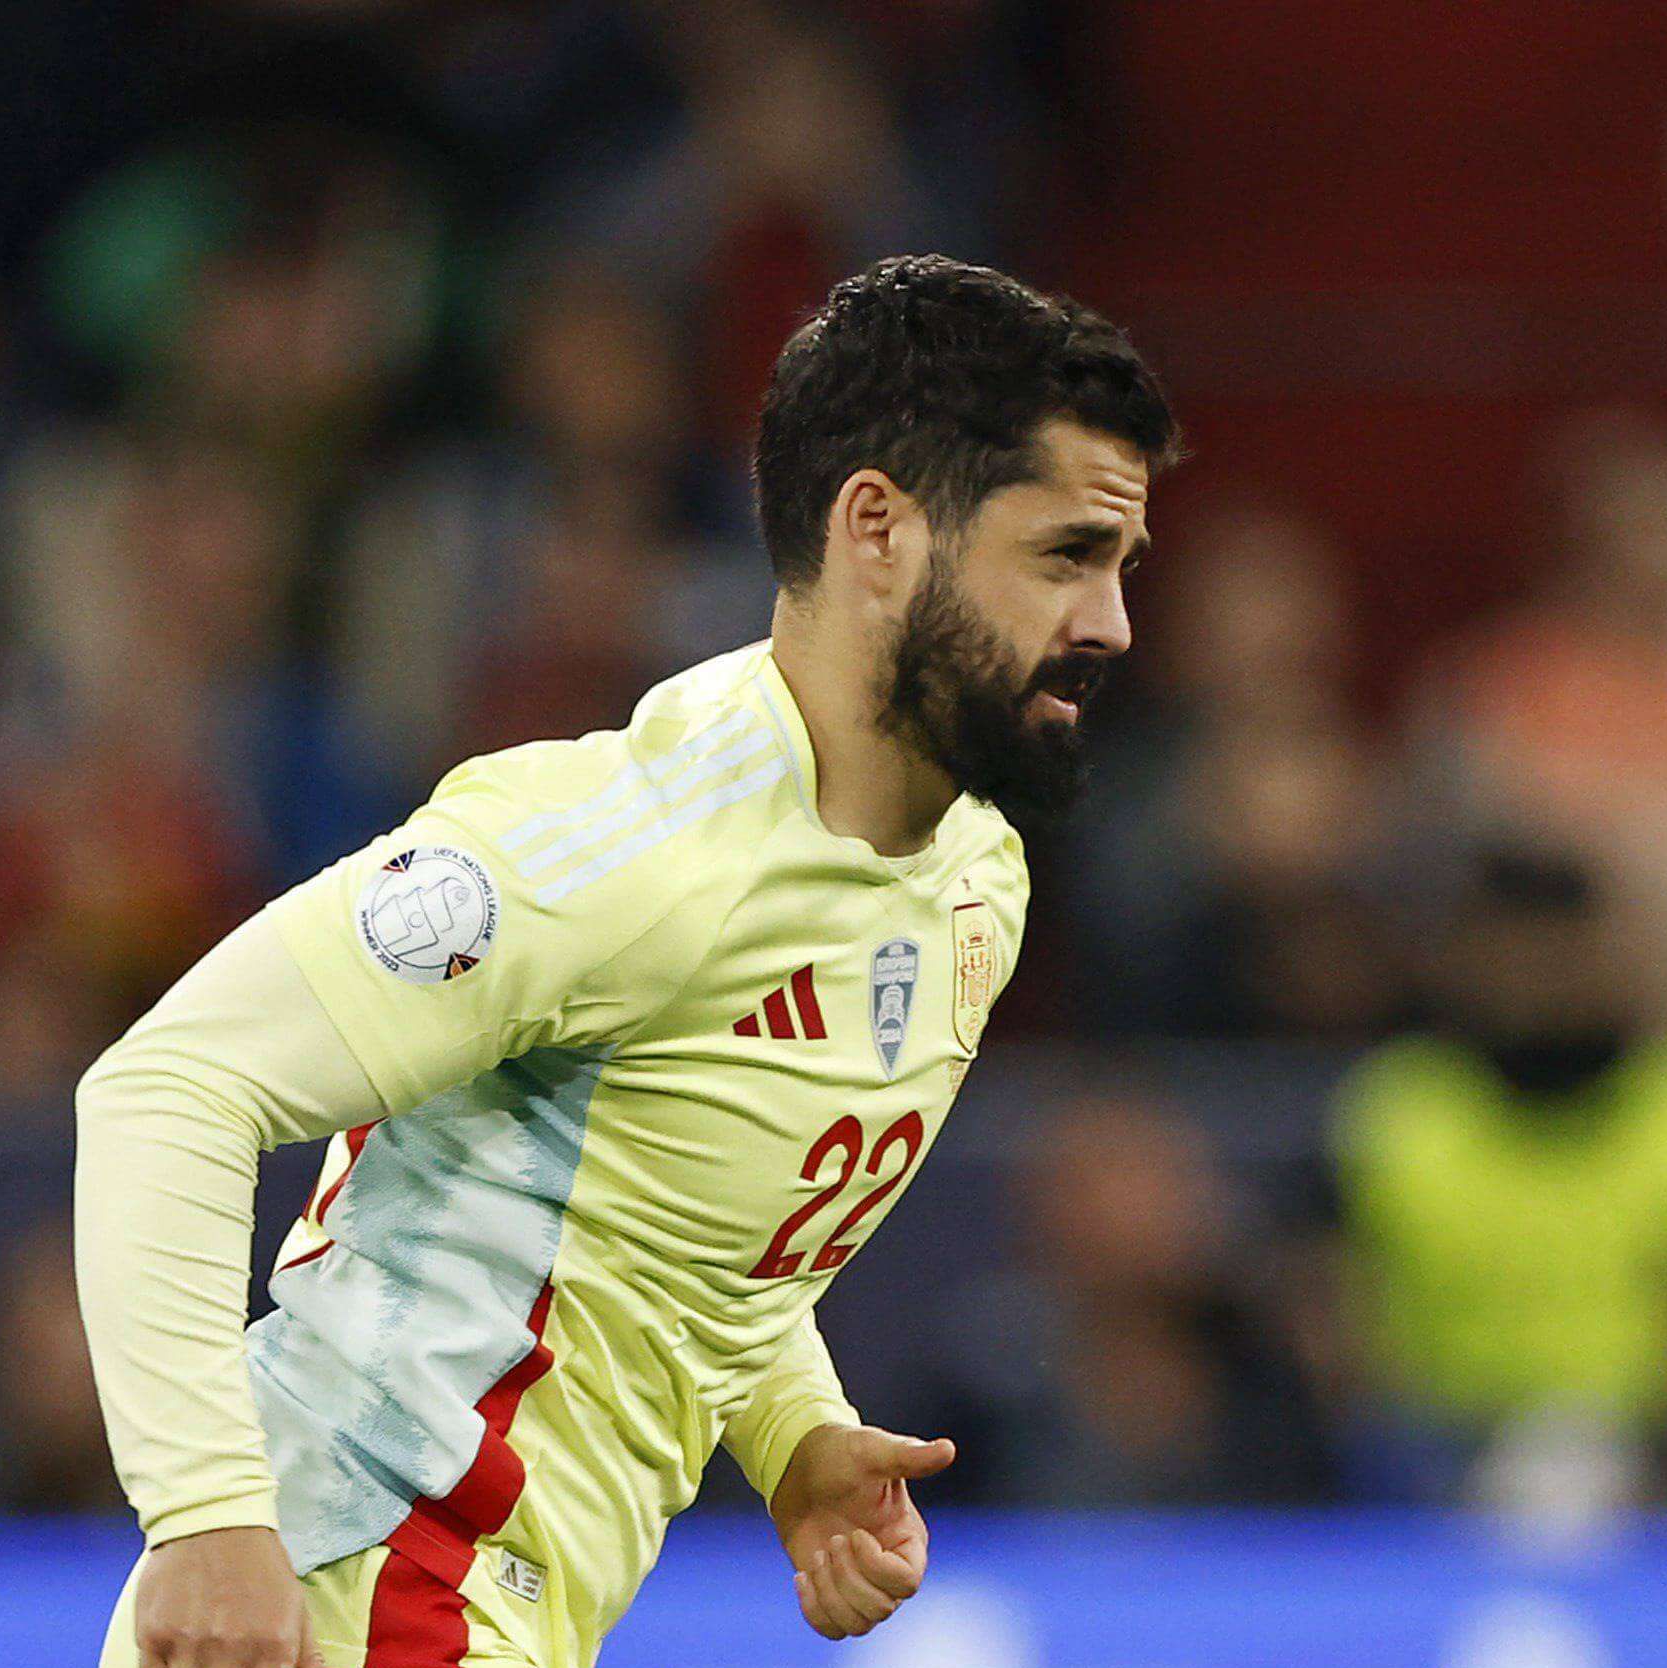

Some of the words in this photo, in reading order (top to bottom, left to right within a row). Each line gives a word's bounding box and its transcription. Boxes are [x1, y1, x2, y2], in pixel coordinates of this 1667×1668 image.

[434, 848, 458, 860] UEFA
[461, 856, 493, 897] NATIONS
[482, 898, 497, 942] LEAGUE
[746, 1110, 924, 1279] 22
